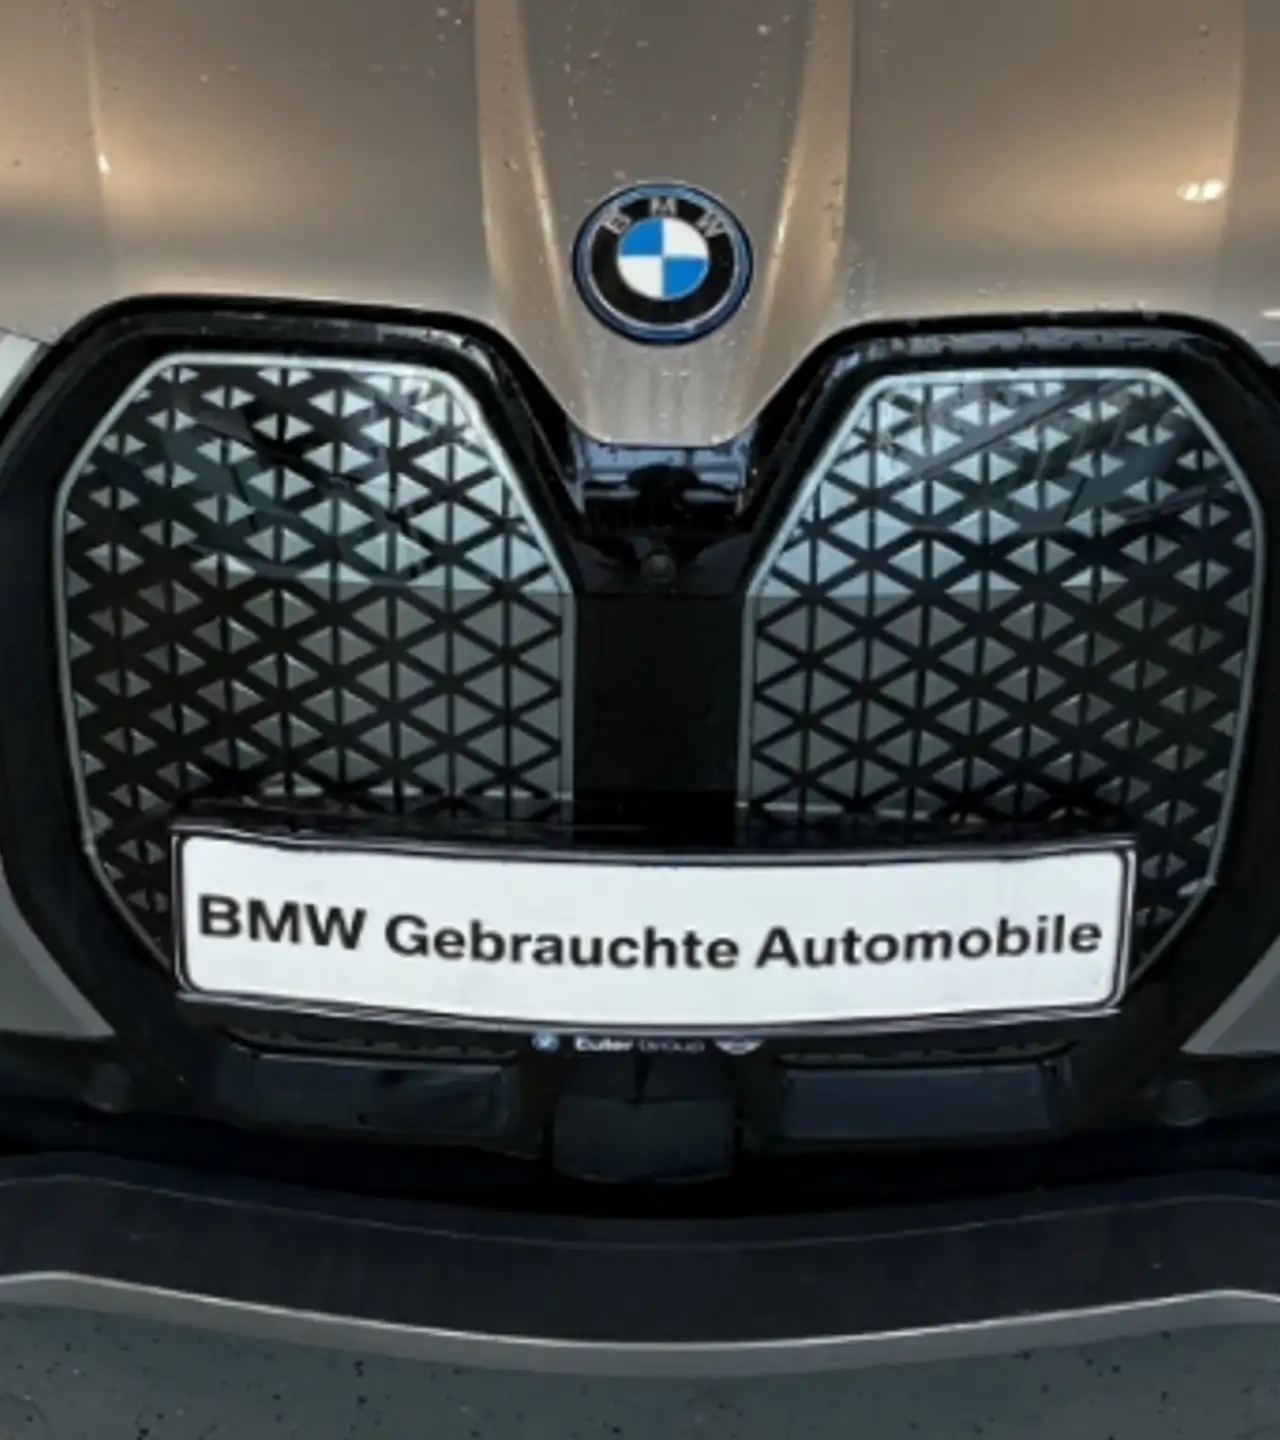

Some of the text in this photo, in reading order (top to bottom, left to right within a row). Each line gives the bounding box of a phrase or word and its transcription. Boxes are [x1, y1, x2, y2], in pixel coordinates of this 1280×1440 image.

[197, 892, 1104, 970] BMW Gebrauchte Automobile
